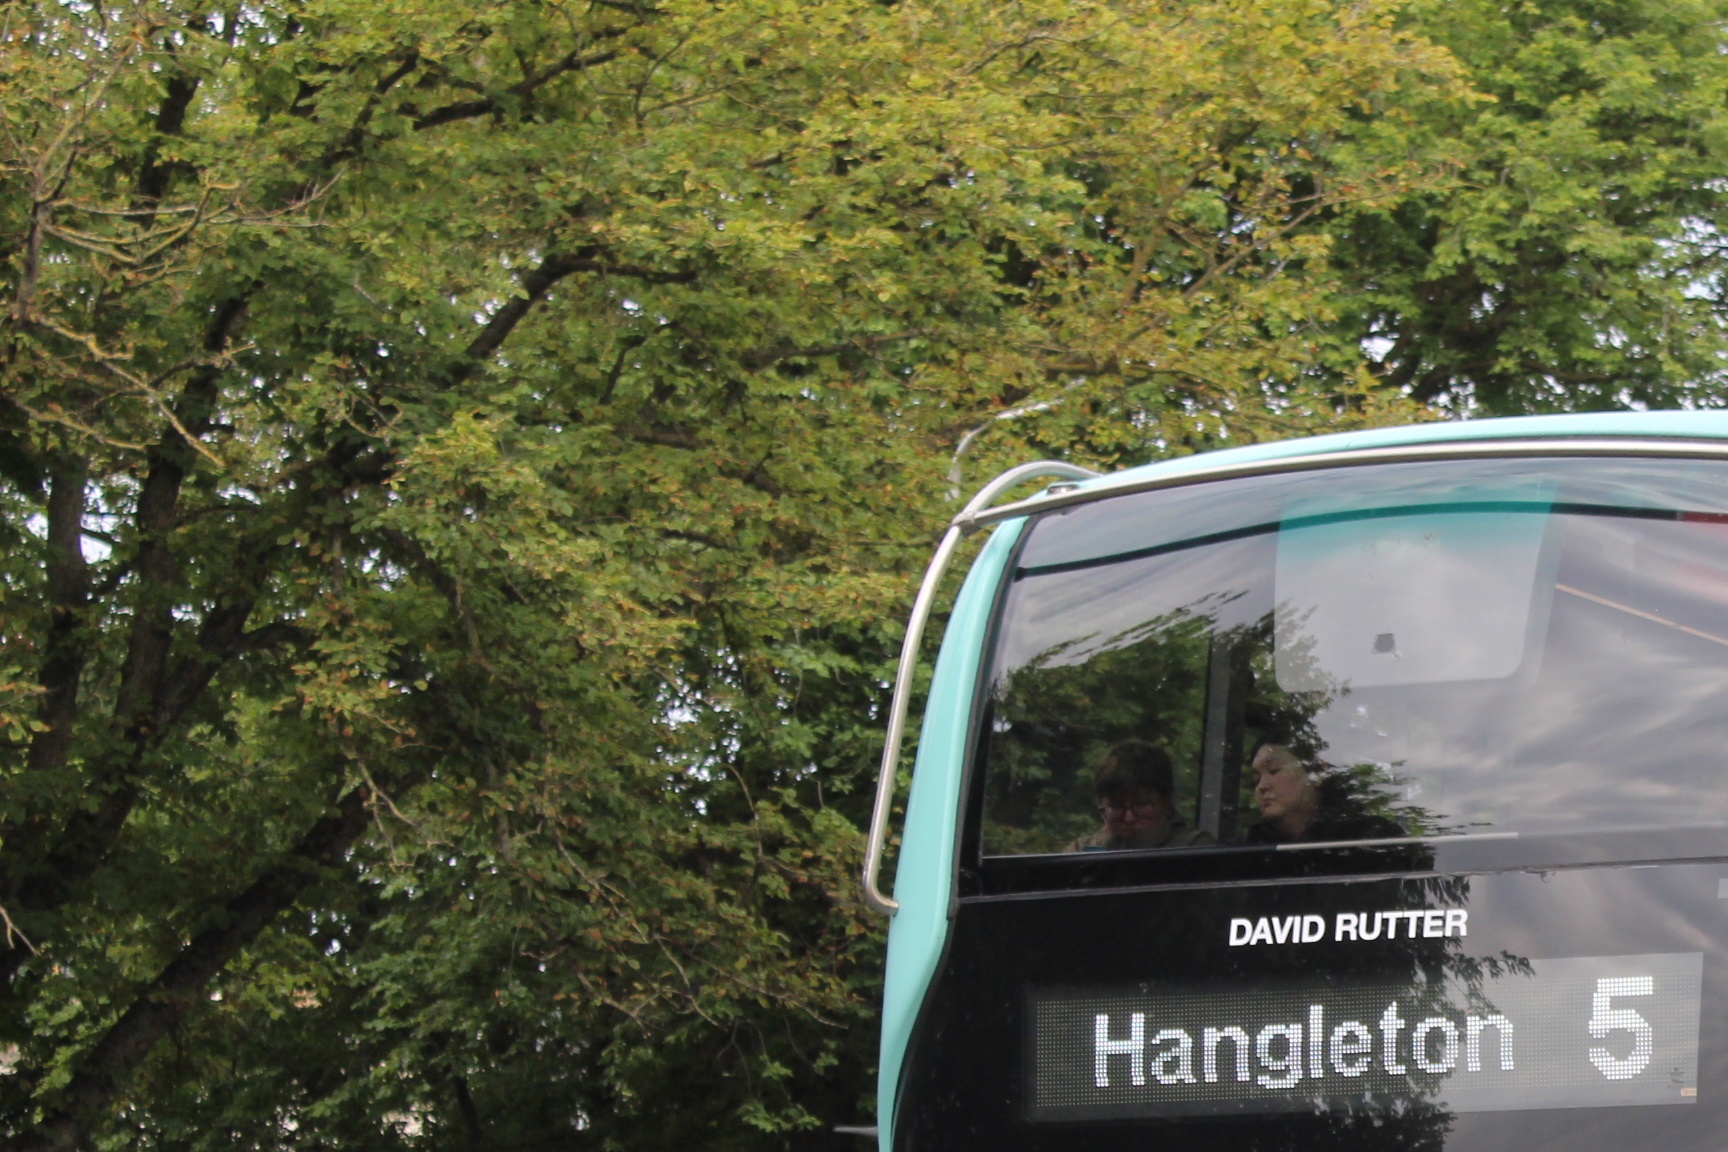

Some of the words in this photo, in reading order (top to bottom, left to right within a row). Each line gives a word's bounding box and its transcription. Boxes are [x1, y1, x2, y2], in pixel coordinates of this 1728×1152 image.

[1229, 915, 1326, 946] DAVID
[1335, 909, 1468, 942] RUTTER
[1095, 1001, 1514, 1089] Hangleton
[1589, 976, 1653, 1080] 5
